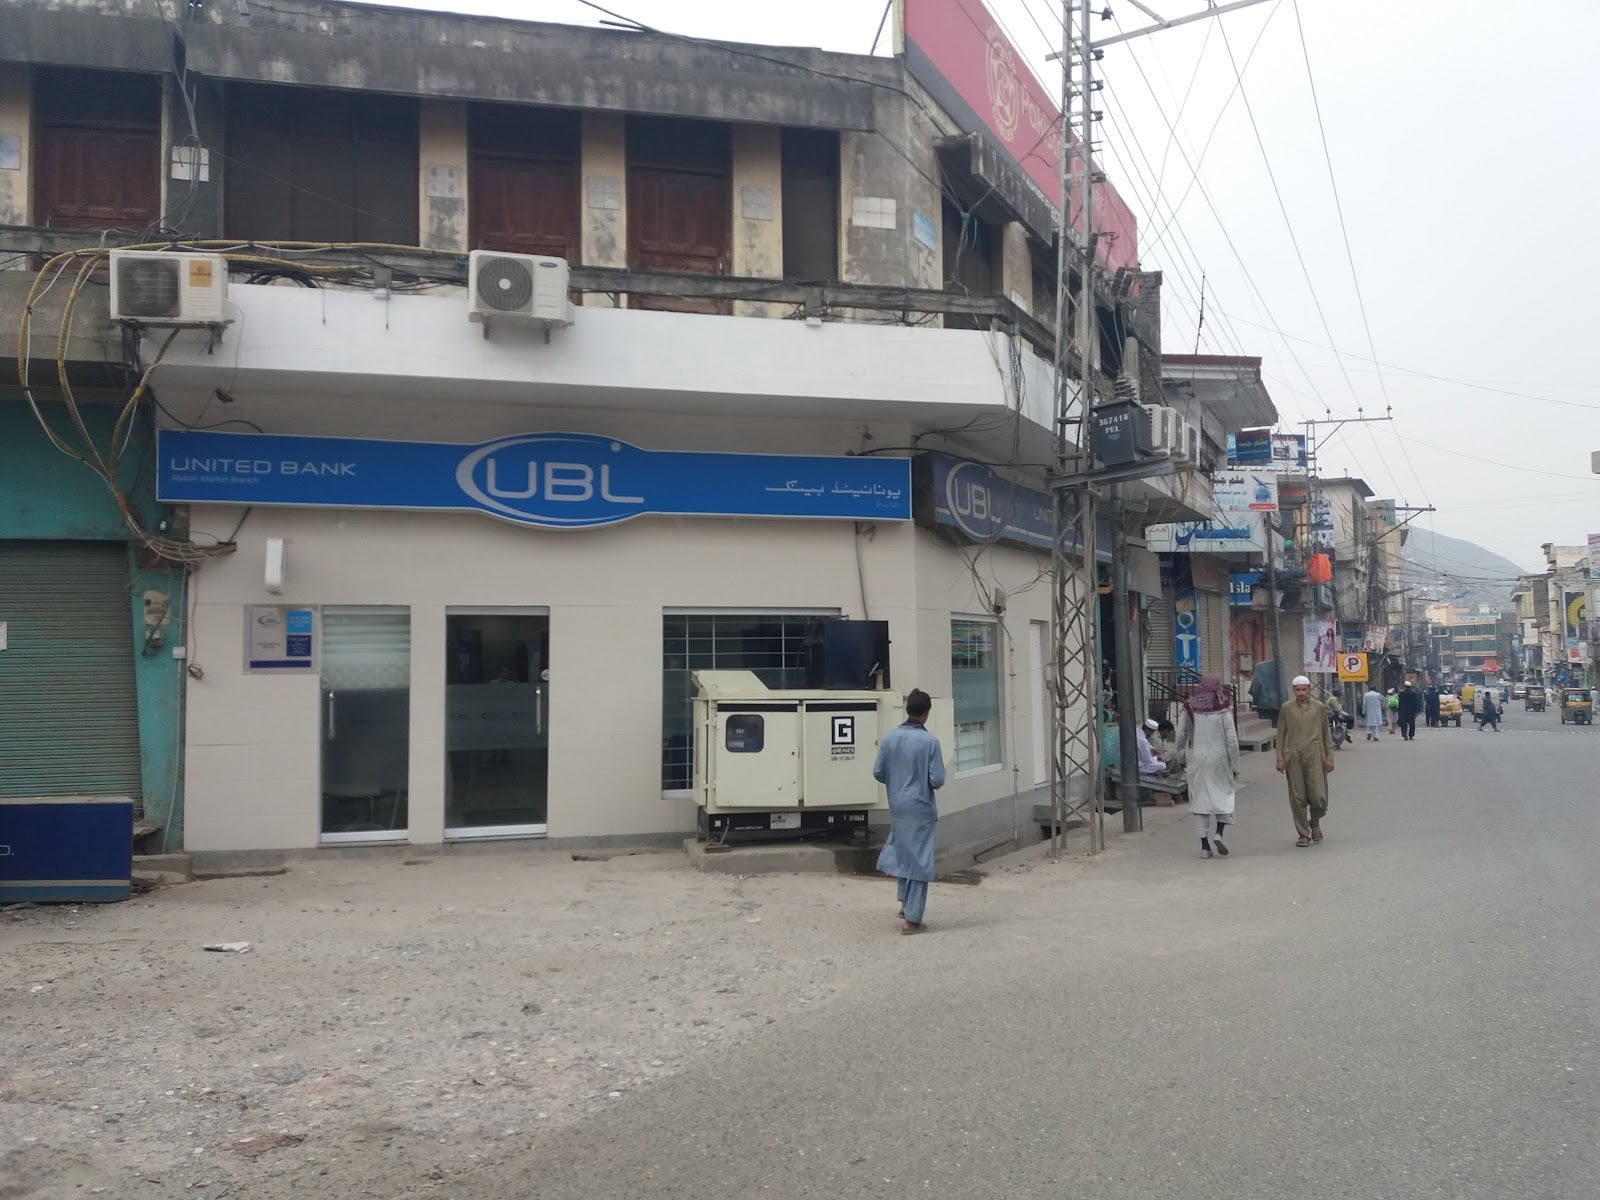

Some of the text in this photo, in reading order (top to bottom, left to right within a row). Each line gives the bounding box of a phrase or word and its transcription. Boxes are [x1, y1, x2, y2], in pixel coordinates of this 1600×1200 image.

[171, 458, 357, 476] UNITED BANK
[486, 458, 645, 503] UBL
[954, 478, 1001, 523] UBL
[1229, 582, 1251, 594] Isla
